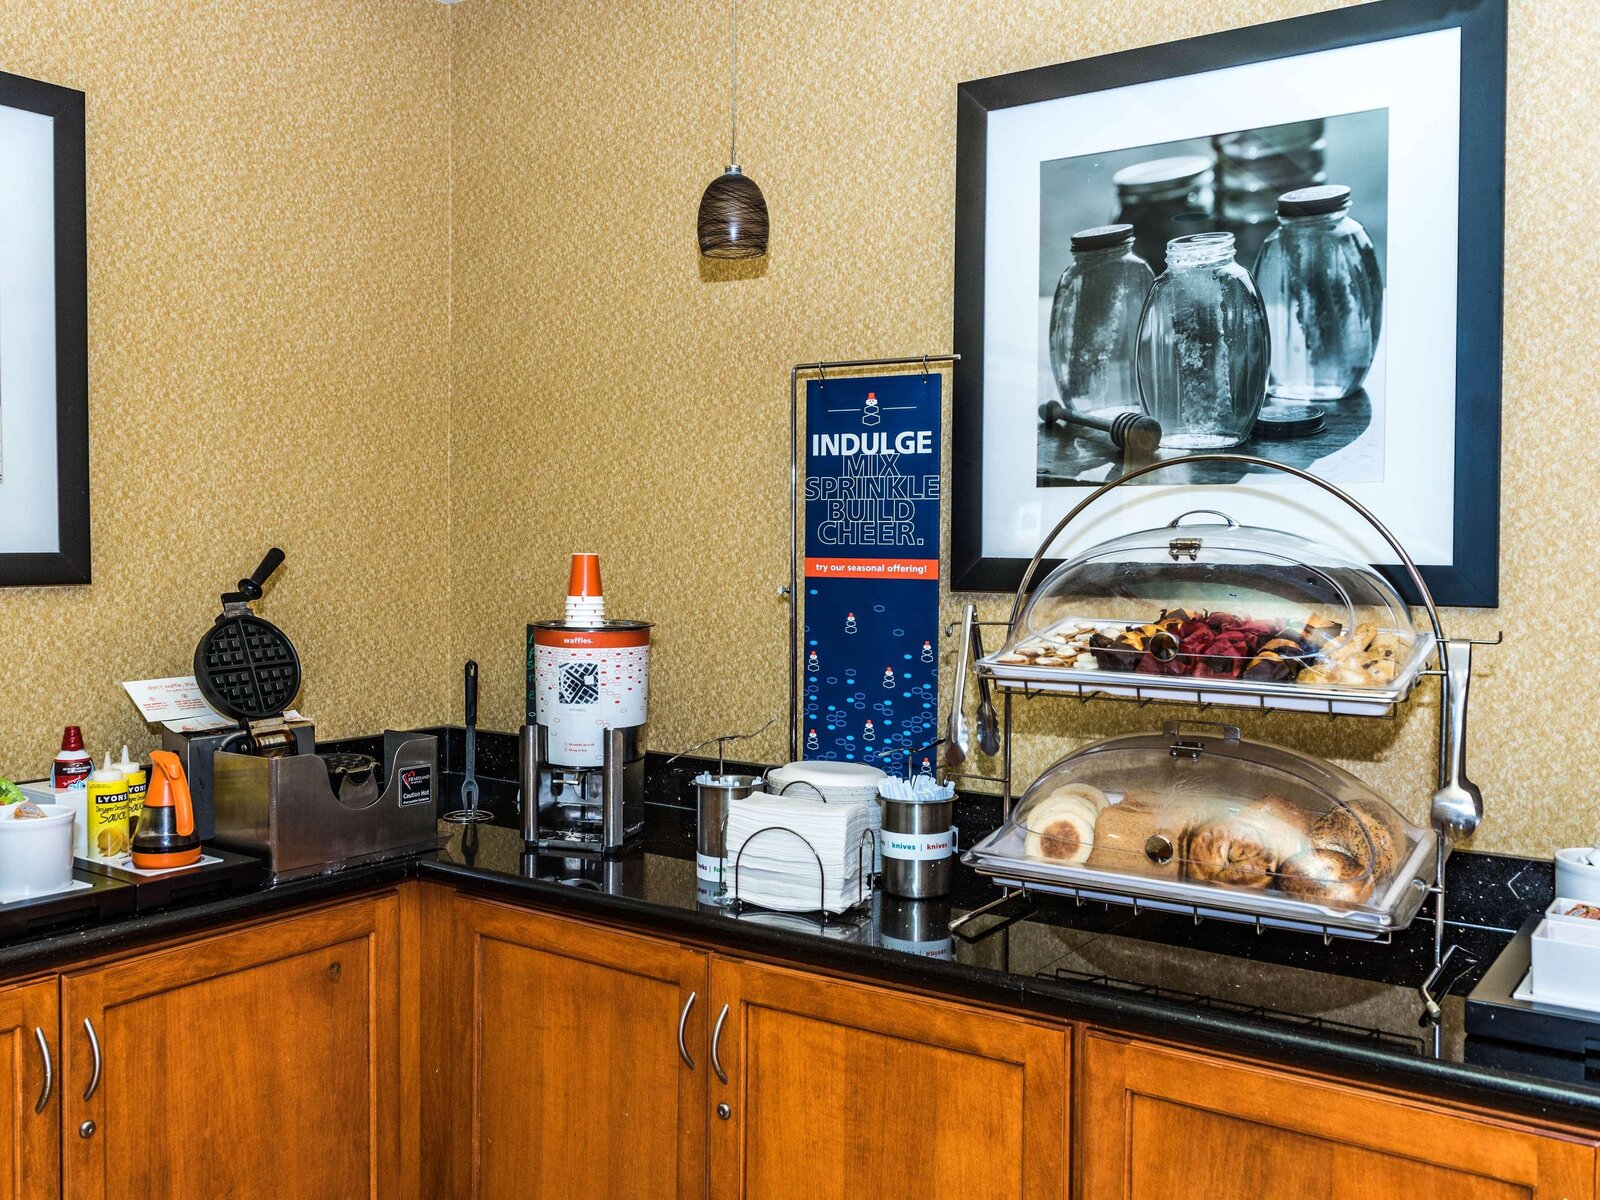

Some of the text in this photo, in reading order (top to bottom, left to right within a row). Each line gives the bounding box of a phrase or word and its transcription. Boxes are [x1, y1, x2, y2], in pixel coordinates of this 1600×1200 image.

[812, 430, 933, 457] INDULGE
[842, 453, 901, 477] MIX
[805, 475, 940, 501] SPRINKLE
[827, 498, 916, 523] BUILD
[817, 520, 925, 546] CHEER.
[815, 563, 927, 575] try our seasonal offering!
[97, 793, 128, 804] LYONS
[402, 792, 421, 800] Caution
[99, 811, 127, 825] Sauce
[891, 841, 916, 851] knives
[926, 842, 948, 851] knives
